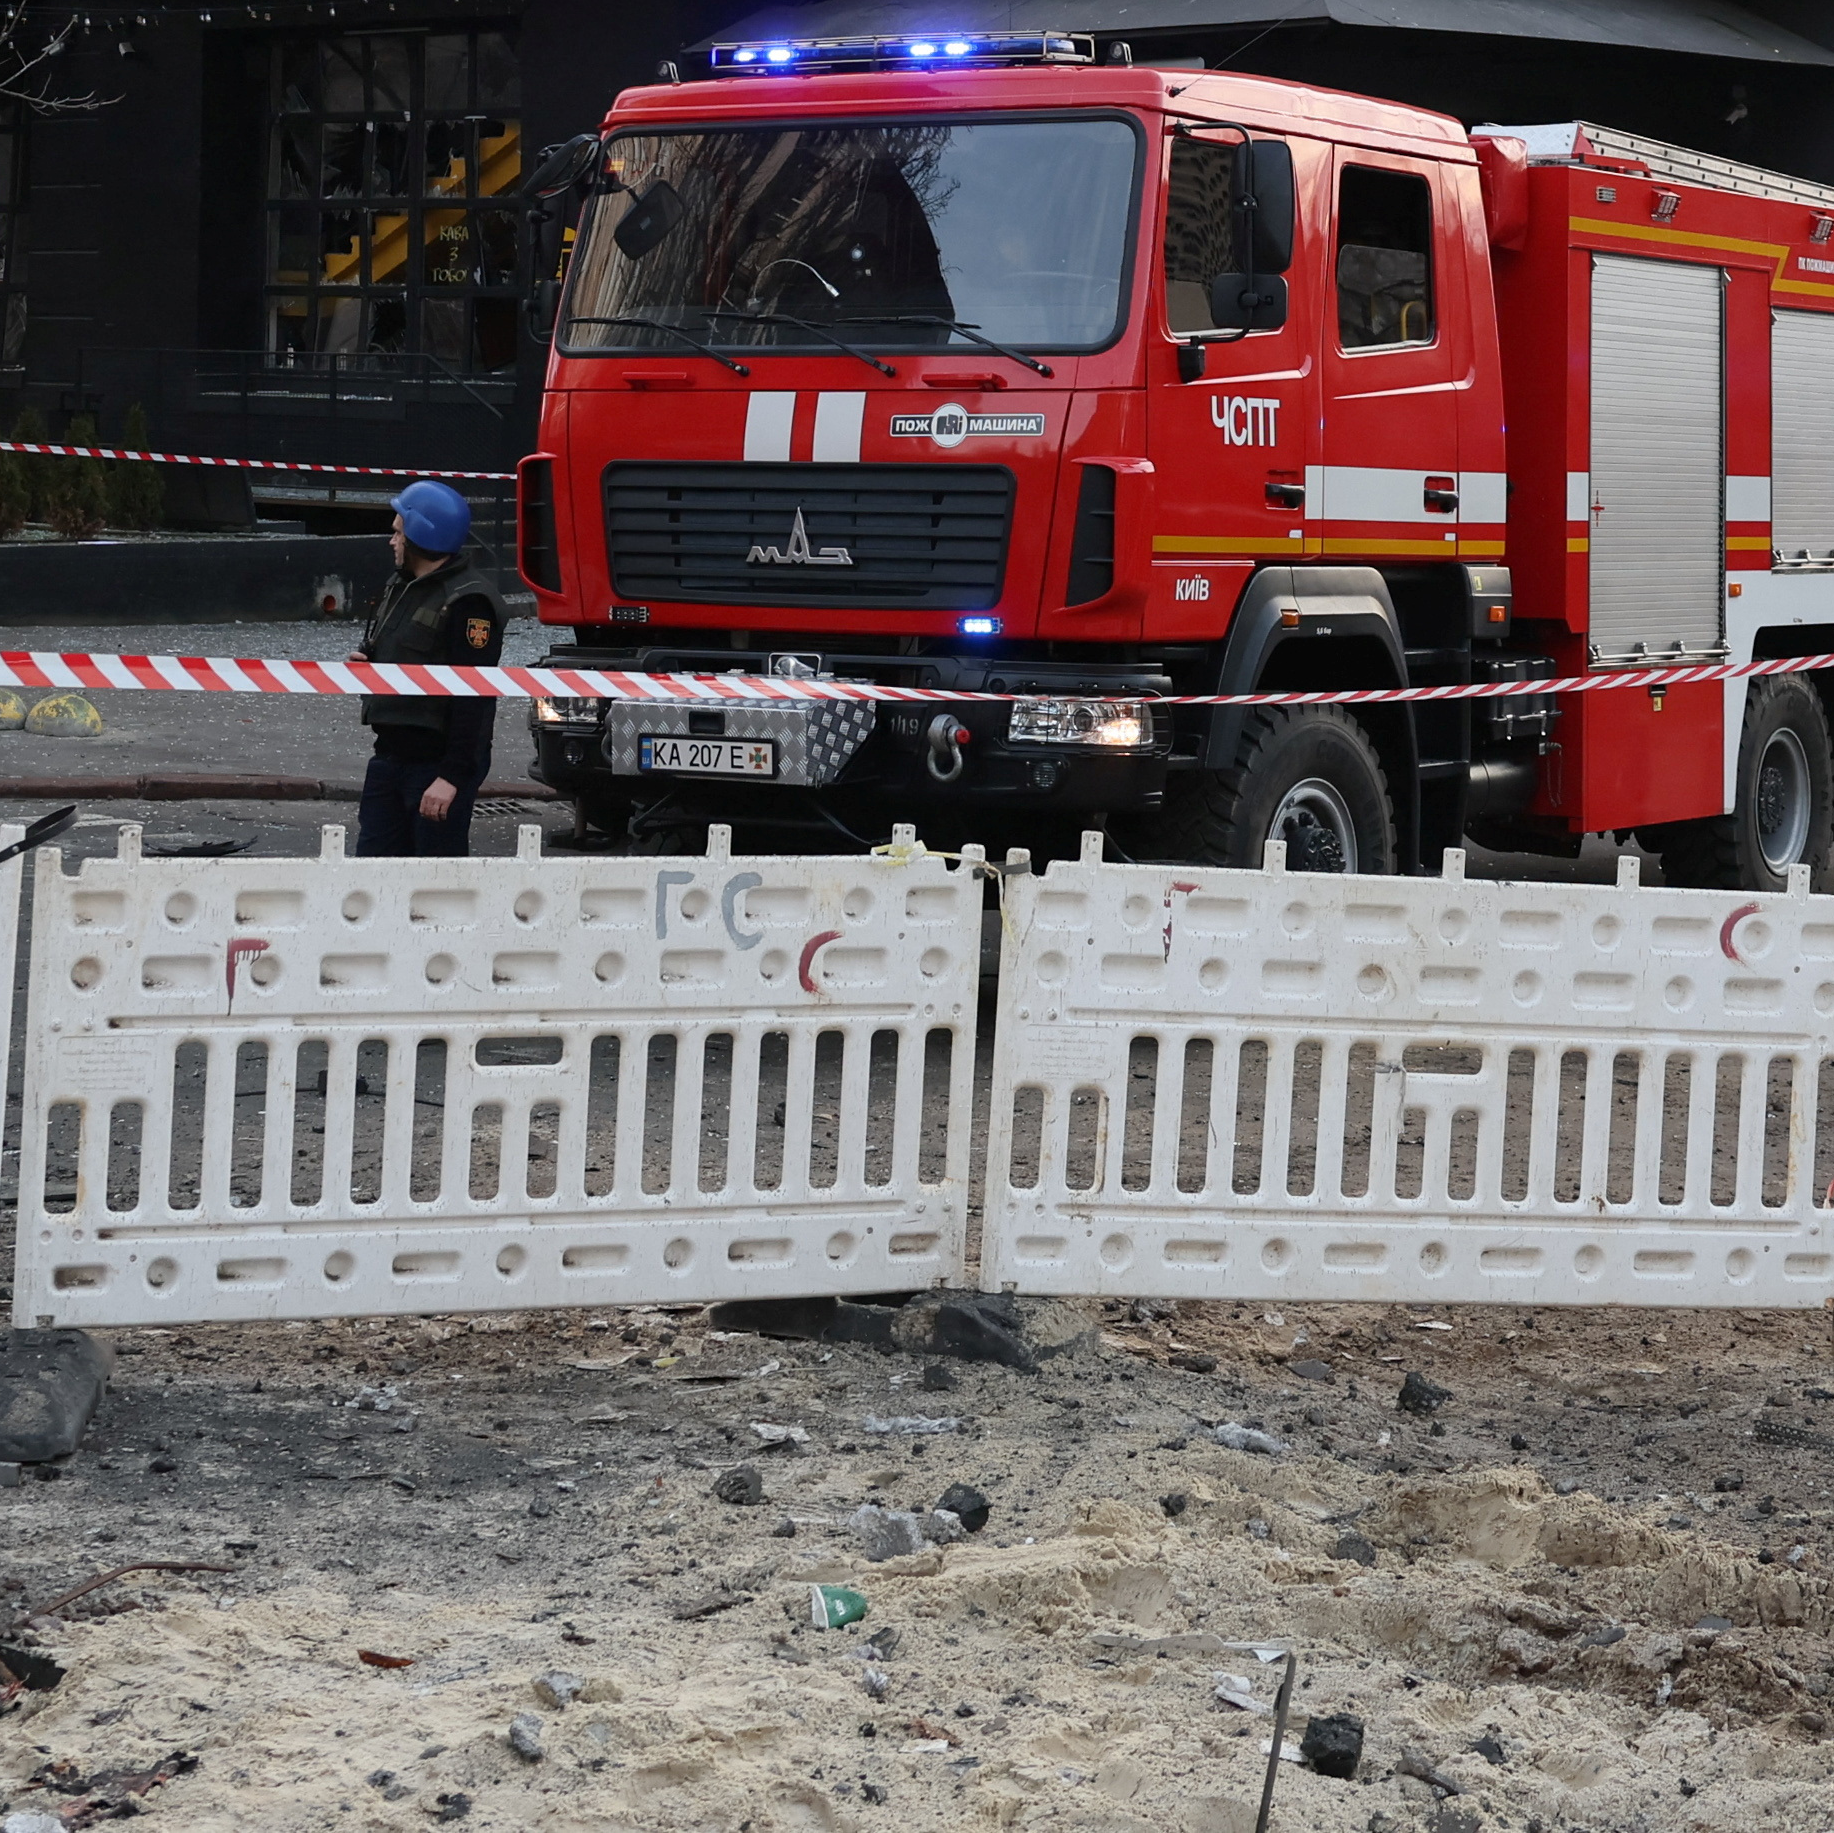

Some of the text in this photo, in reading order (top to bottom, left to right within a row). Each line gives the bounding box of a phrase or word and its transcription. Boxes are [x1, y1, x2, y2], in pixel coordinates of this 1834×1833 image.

[439, 225, 470, 241] КАВА
[895, 419, 930, 432] ПОЖ
[1211, 395, 1280, 446] ЧСПТ
[746, 506, 854, 565] МАЗ
[1175, 574, 1210, 601] КИЇВ
[653, 741, 745, 769] KA 207 E
